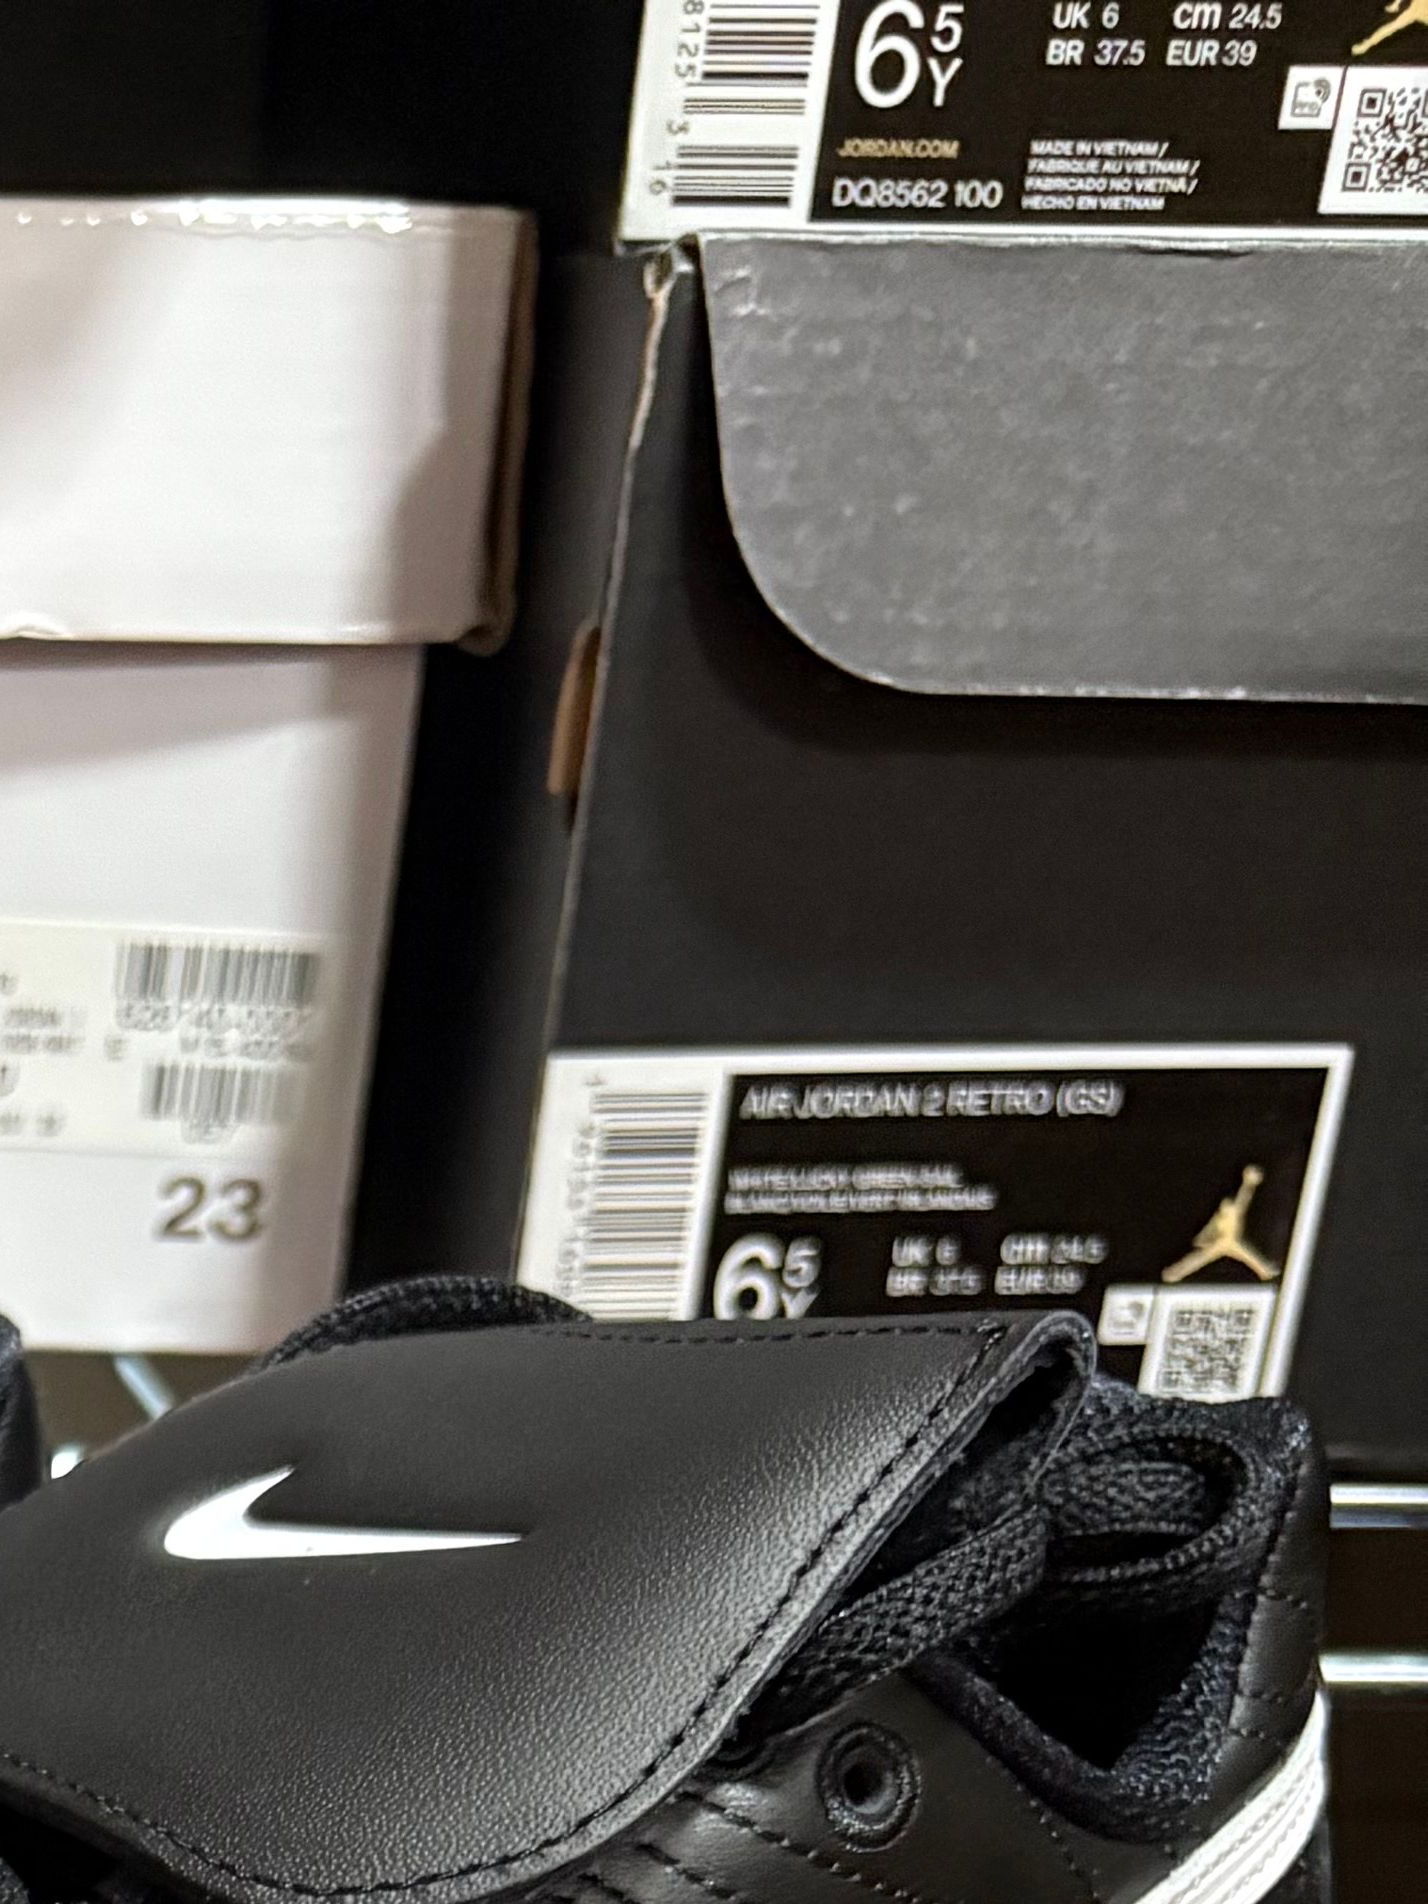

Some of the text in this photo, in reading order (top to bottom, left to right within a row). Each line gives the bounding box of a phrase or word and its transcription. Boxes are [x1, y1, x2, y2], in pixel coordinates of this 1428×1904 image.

[1052, 2, 1090, 30] UK
[1101, 3, 1120, 29] 6
[1228, 3, 1282, 30] 24.5
[1045, 39, 1258, 67] BR 37.5 EUR 39
[837, 138, 961, 160] JORDAN.COM
[1030, 140, 1075, 156] MADE
[1093, 140, 1159, 156] VIETNAM
[1124, 158, 1190, 175] VIETNAM
[831, 177, 1004, 210] DQ8562 100
[1099, 196, 1166, 211] VIETNAM
[740, 1082, 794, 1120] AIR
[794, 1081, 923, 1119] JORDAN
[946, 1079, 1056, 1118] RETRO
[153, 1172, 264, 1245] 23
